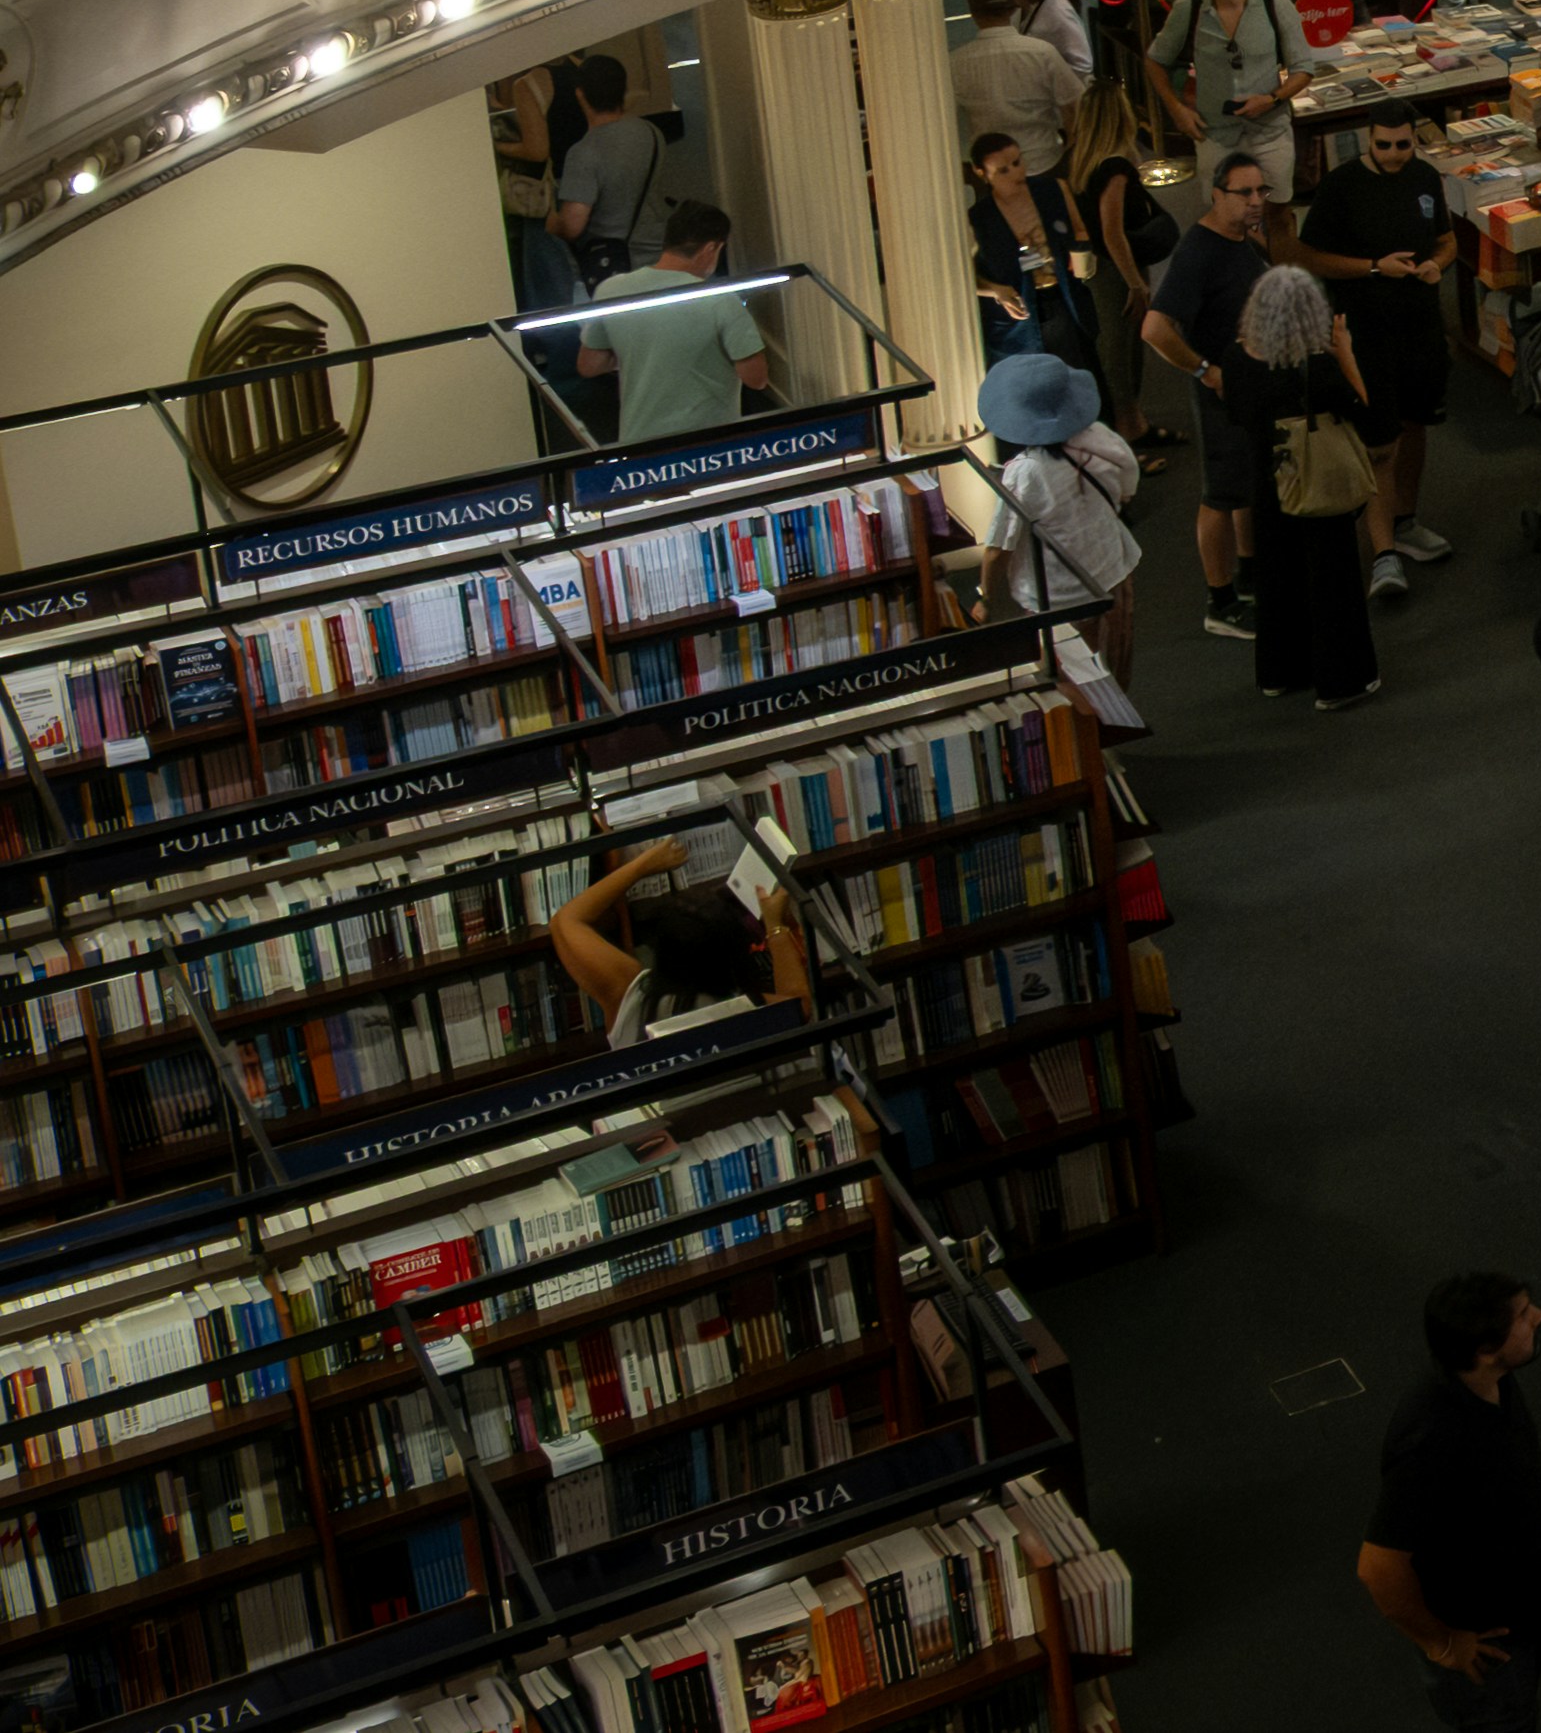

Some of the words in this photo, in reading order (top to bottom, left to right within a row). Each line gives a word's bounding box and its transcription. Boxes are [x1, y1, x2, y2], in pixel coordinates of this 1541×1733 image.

[610, 428, 839, 494] ADMINISTRACION
[237, 518, 386, 569] RECURSOS
[391, 492, 535, 540] HUMANOS
[0, 590, 89, 626] ANZAS
[683, 689, 813, 736] POLÍTICA
[816, 652, 956, 703] NACIONAL
[308, 772, 465, 825] NACIONAL
[661, 1483, 854, 1568] HISTORIA
